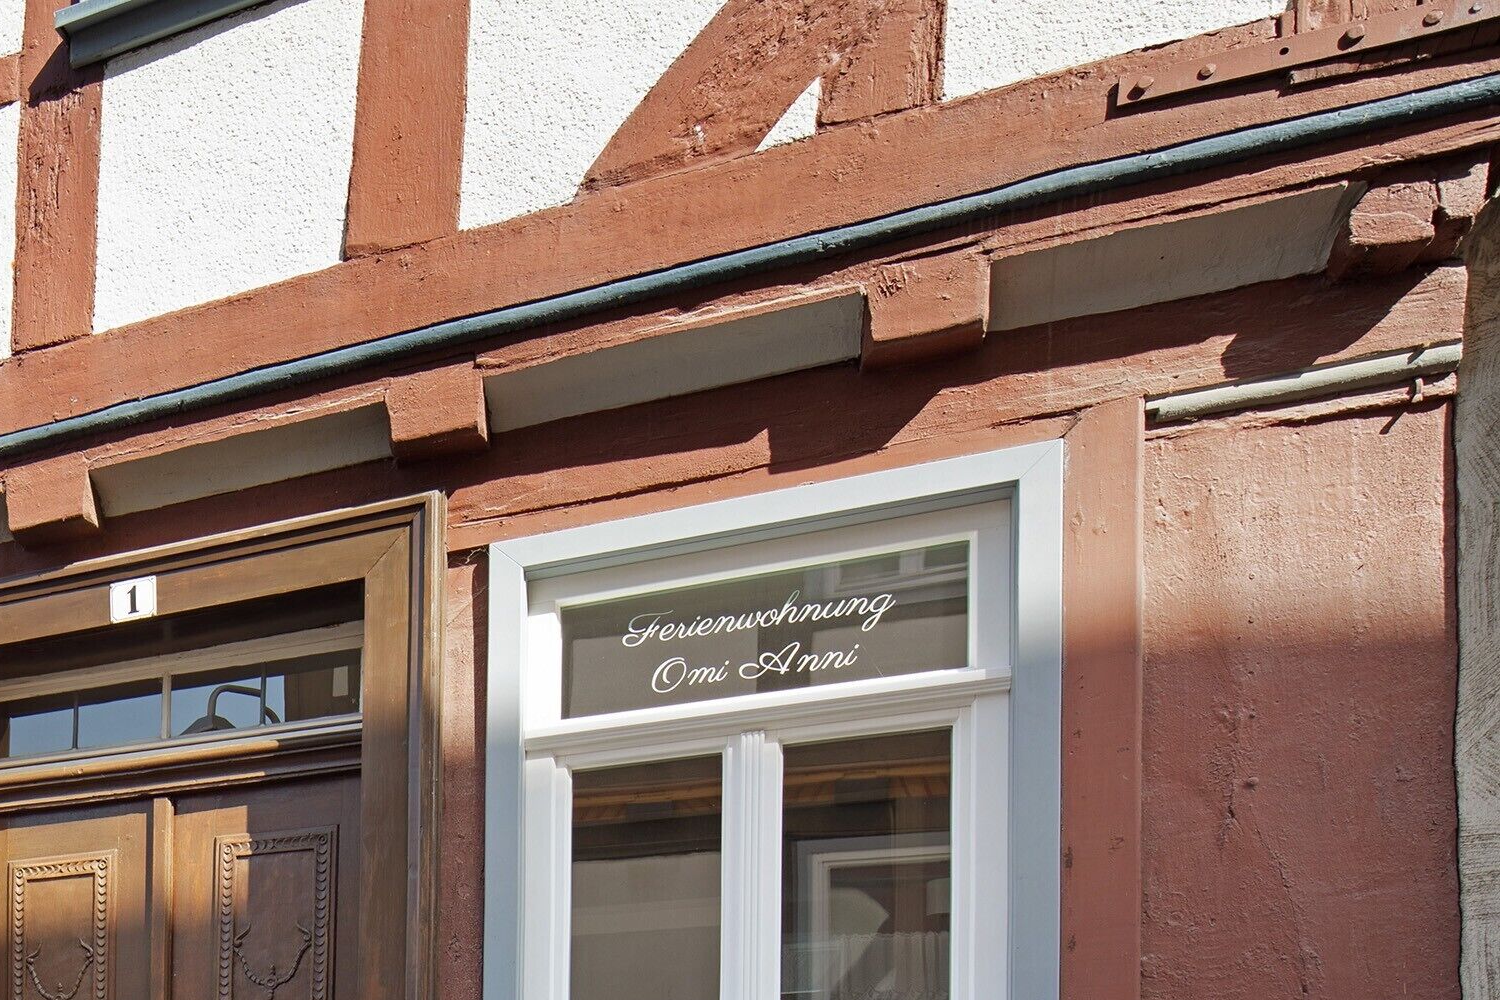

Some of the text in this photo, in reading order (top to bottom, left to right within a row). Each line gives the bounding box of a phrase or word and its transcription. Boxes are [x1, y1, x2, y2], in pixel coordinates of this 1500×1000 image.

[127, 585, 140, 615] 1
[621, 589, 897, 648] Ferienwohnung
[651, 641, 860, 694] Omi Anni
